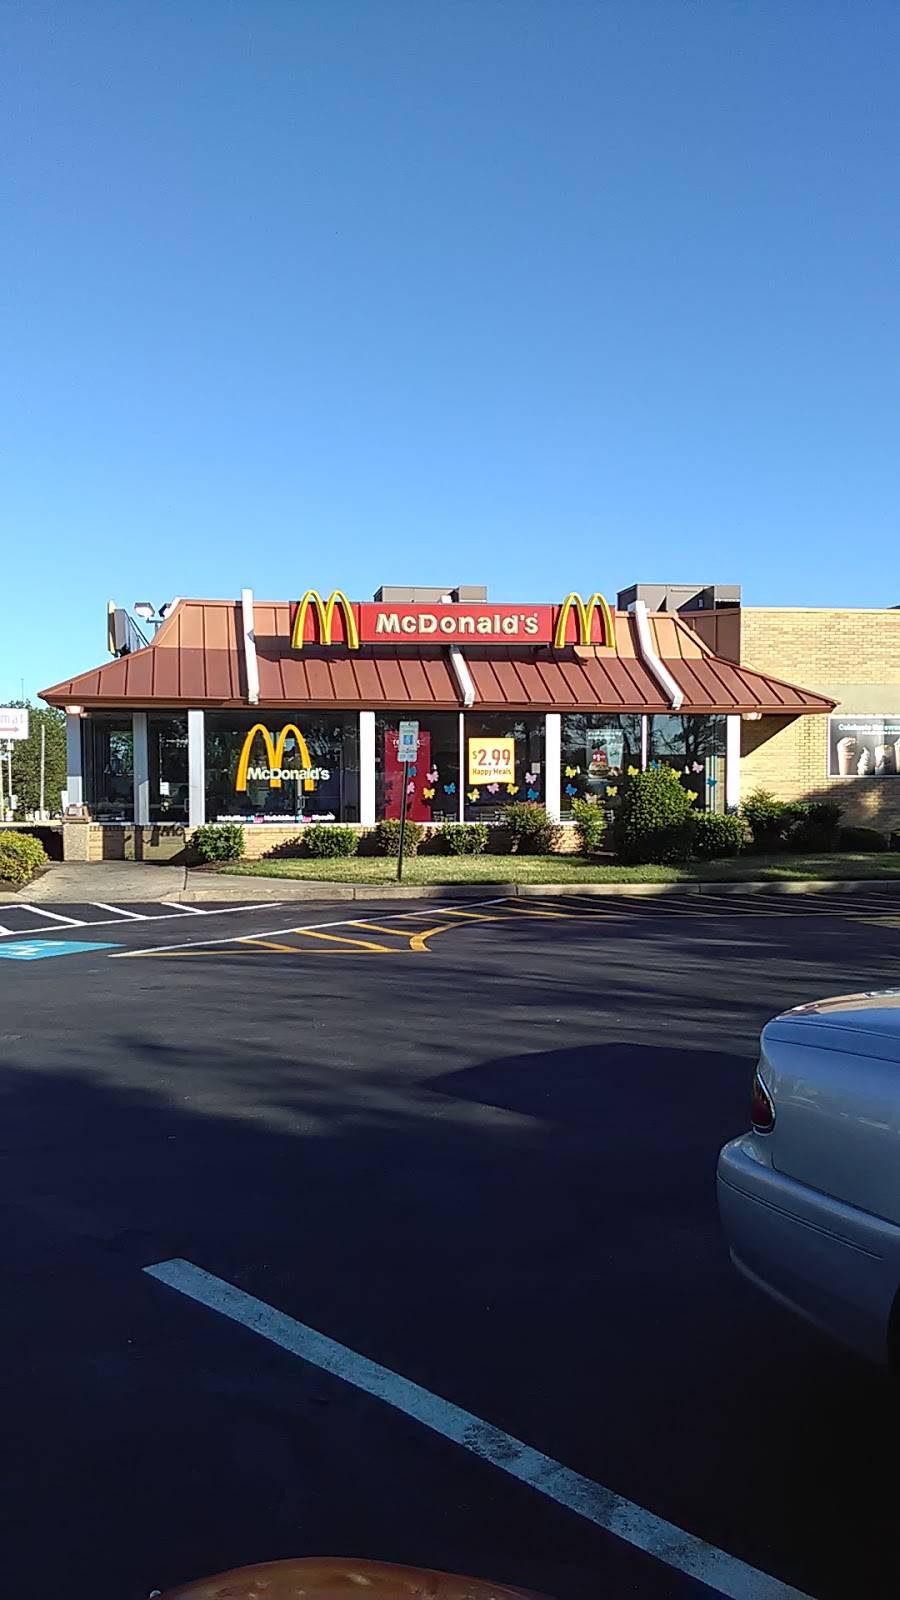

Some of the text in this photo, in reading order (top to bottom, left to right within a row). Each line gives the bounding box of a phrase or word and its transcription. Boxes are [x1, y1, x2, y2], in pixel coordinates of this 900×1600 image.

[375, 613, 539, 634] McDonald's
[472, 748, 511, 766] $2.99
[246, 766, 330, 780] McDonald's
